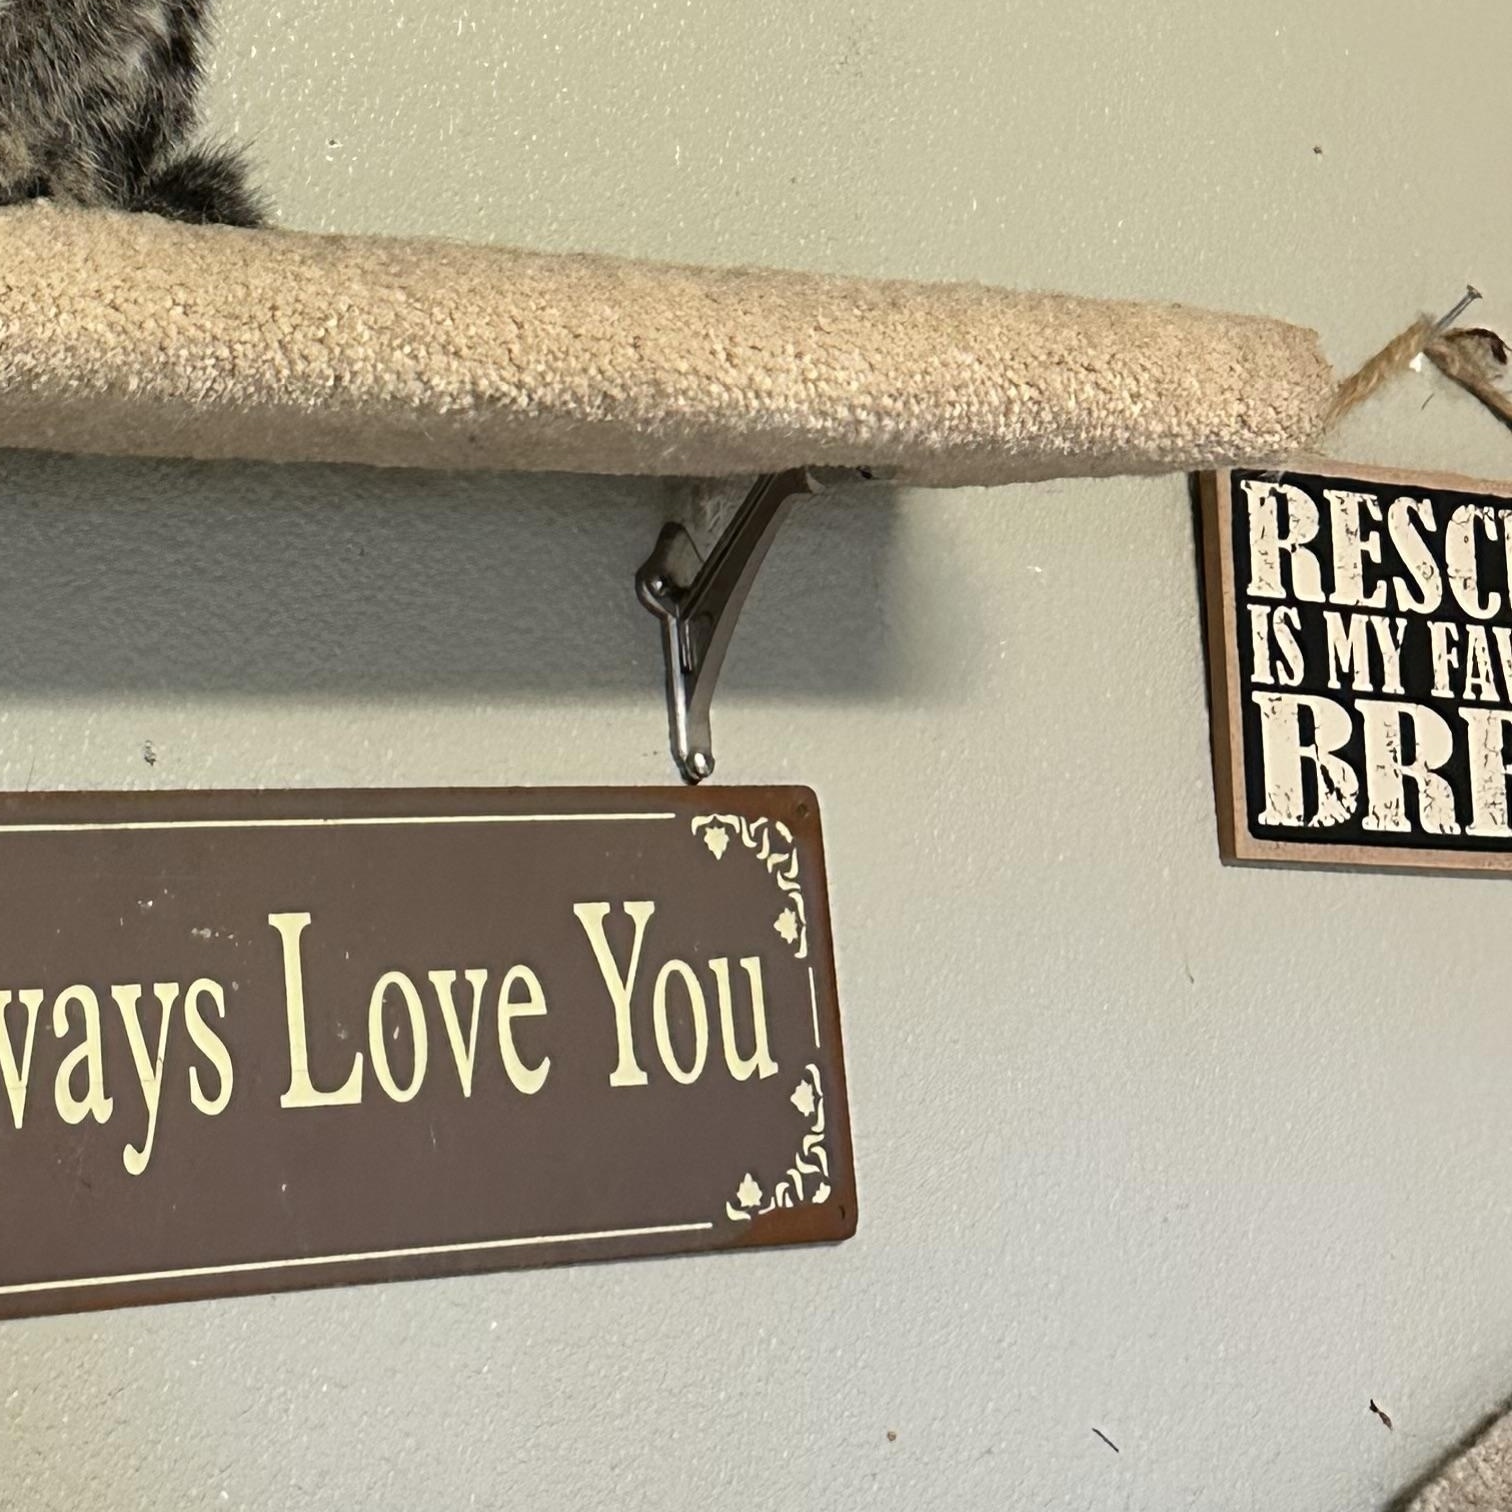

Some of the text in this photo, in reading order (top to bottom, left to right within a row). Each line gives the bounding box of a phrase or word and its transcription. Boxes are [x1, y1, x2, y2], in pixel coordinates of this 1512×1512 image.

[1239, 479, 1512, 621] RESC
[1245, 603, 1306, 686] IS
[1322, 610, 1408, 695] MY
[268, 912, 551, 1109] Love
[573, 900, 780, 1087] You
